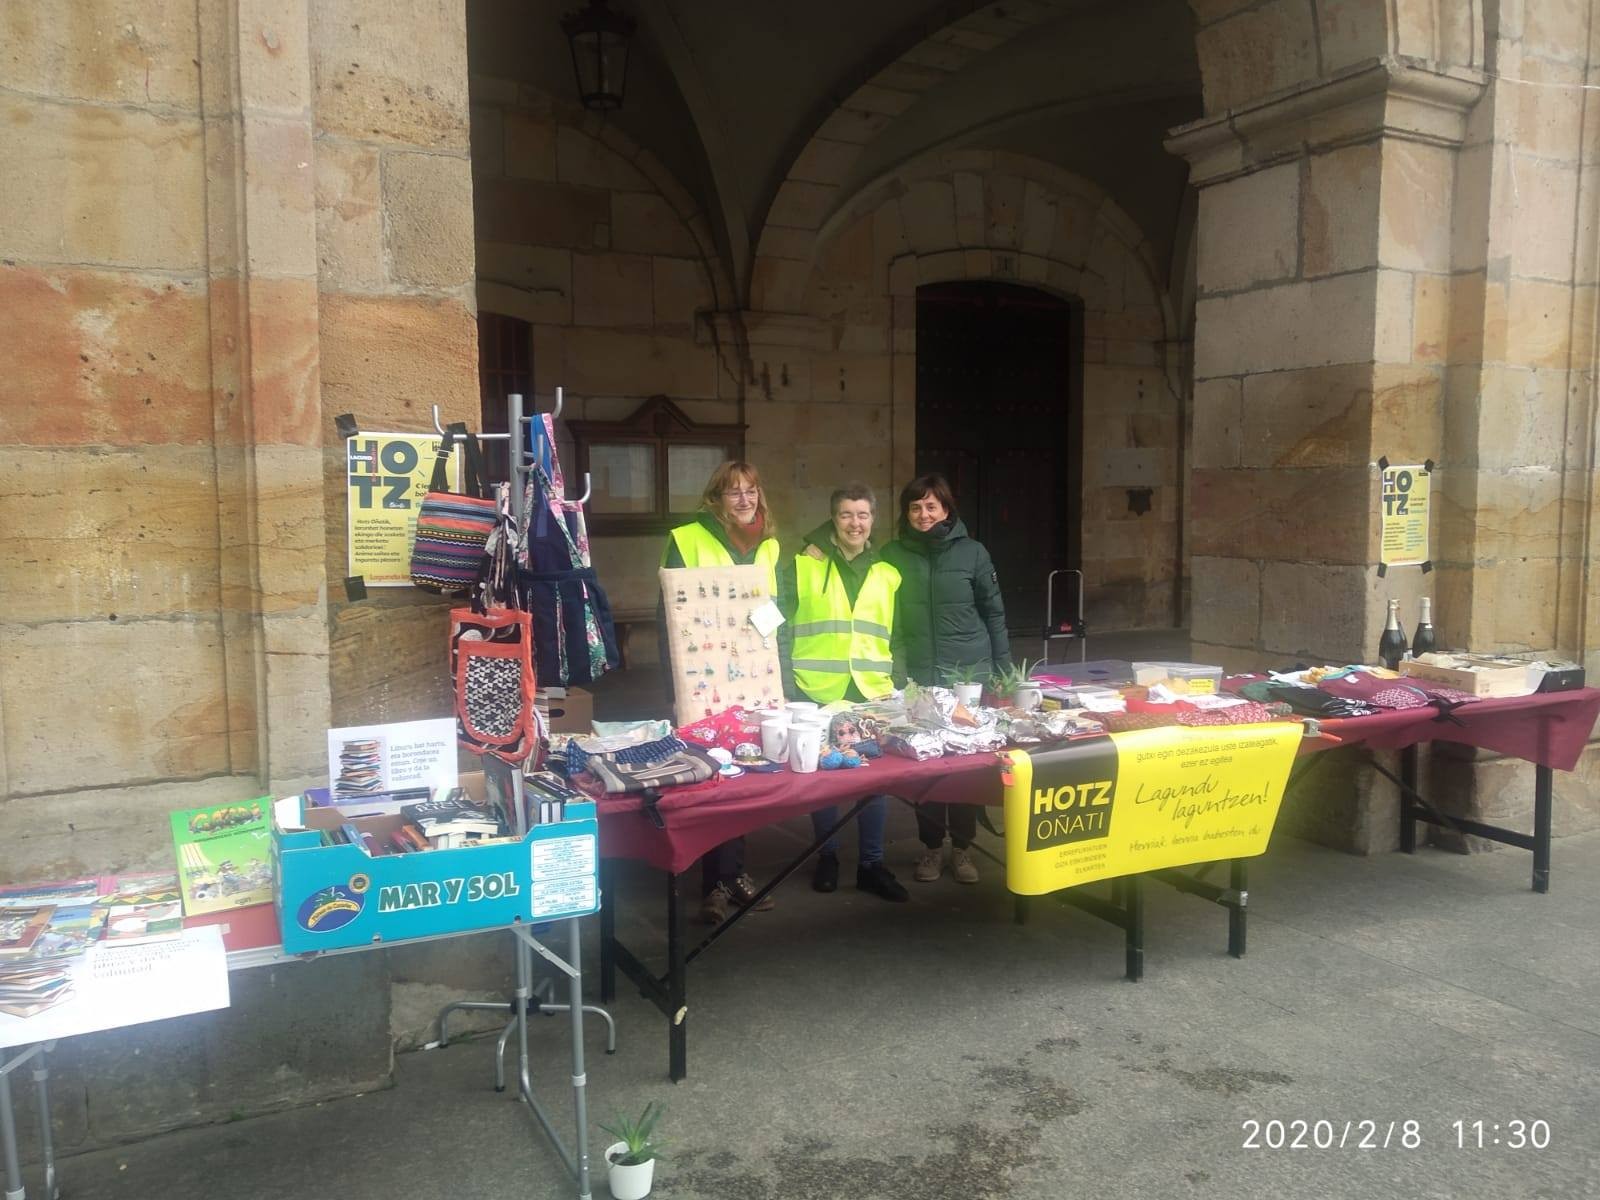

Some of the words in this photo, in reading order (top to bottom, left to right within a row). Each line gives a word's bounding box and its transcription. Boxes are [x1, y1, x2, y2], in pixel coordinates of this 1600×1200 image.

[350, 440, 418, 474] HO
[350, 475, 411, 509] TZ
[1383, 470, 1413, 493] HO
[1383, 494, 1409, 516] TZ
[1034, 781, 1112, 815] HOTZ
[1135, 774, 1219, 812] Lagundu
[1172, 781, 1270, 829] laguntzen!
[1037, 812, 1104, 839] OÑATI
[378, 885, 441, 912] MAR
[444, 878, 465, 904] Y
[467, 872, 520, 901] SOL
